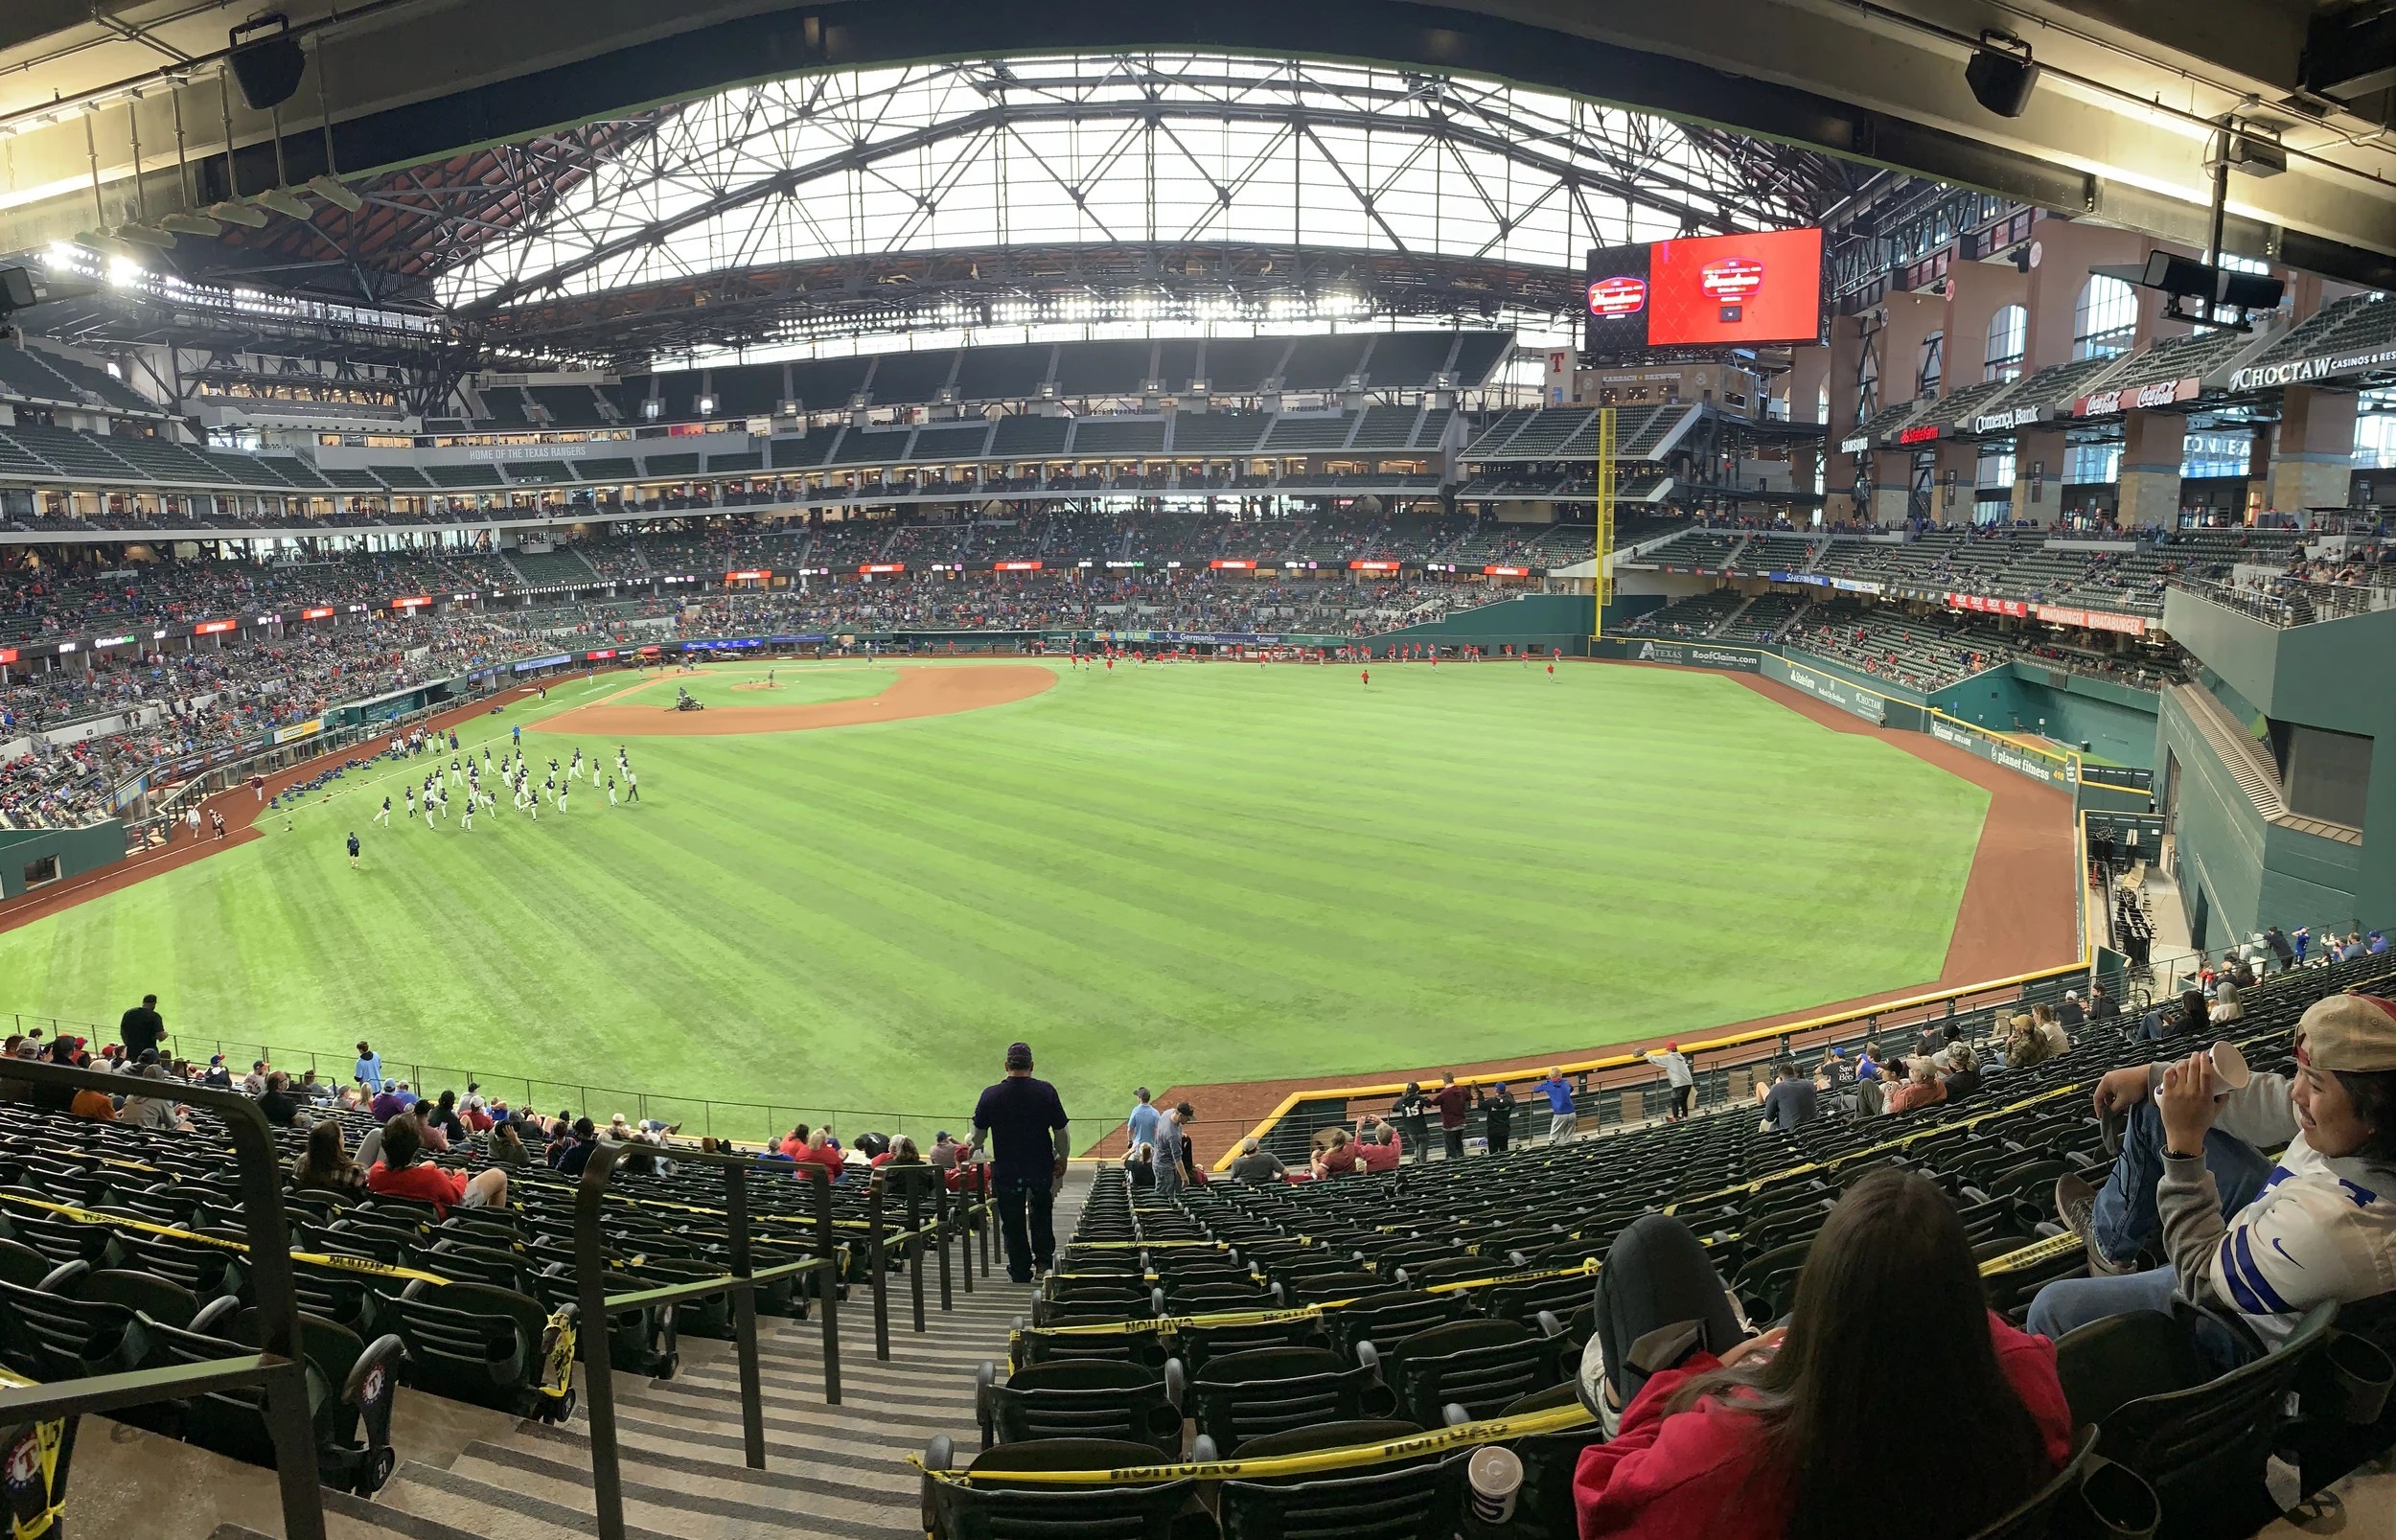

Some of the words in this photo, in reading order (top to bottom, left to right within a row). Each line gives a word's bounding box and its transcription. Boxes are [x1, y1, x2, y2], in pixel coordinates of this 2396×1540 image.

[1550, 352, 1565, 373] T
[2240, 356, 2332, 388] CHOCTAW
[2331, 356, 2370, 370] CASINOS
[2015, 405, 2039, 425] Bank
[470, 450, 494, 460] HOME
[495, 450, 506, 459] OF
[508, 448, 522, 458] THE
[524, 448, 549, 458] TEXAS
[551, 446, 587, 457] RANGERS
[1841, 437, 1869, 454] SAMSUNG
[2039, 609, 2085, 627] WHATABURGER
[2087, 613, 2141, 632] WHATABURGER
[1180, 632, 1215, 641] Germania
[1654, 649, 1682, 659] TEXAS
[1693, 650, 1758, 664] RoofClaim.com
[1998, 751, 2021, 770] planet
[2022, 758, 2049, 781] fitness
[2053, 770, 2064, 781] 410
[378, 1460, 387, 1480] 21
